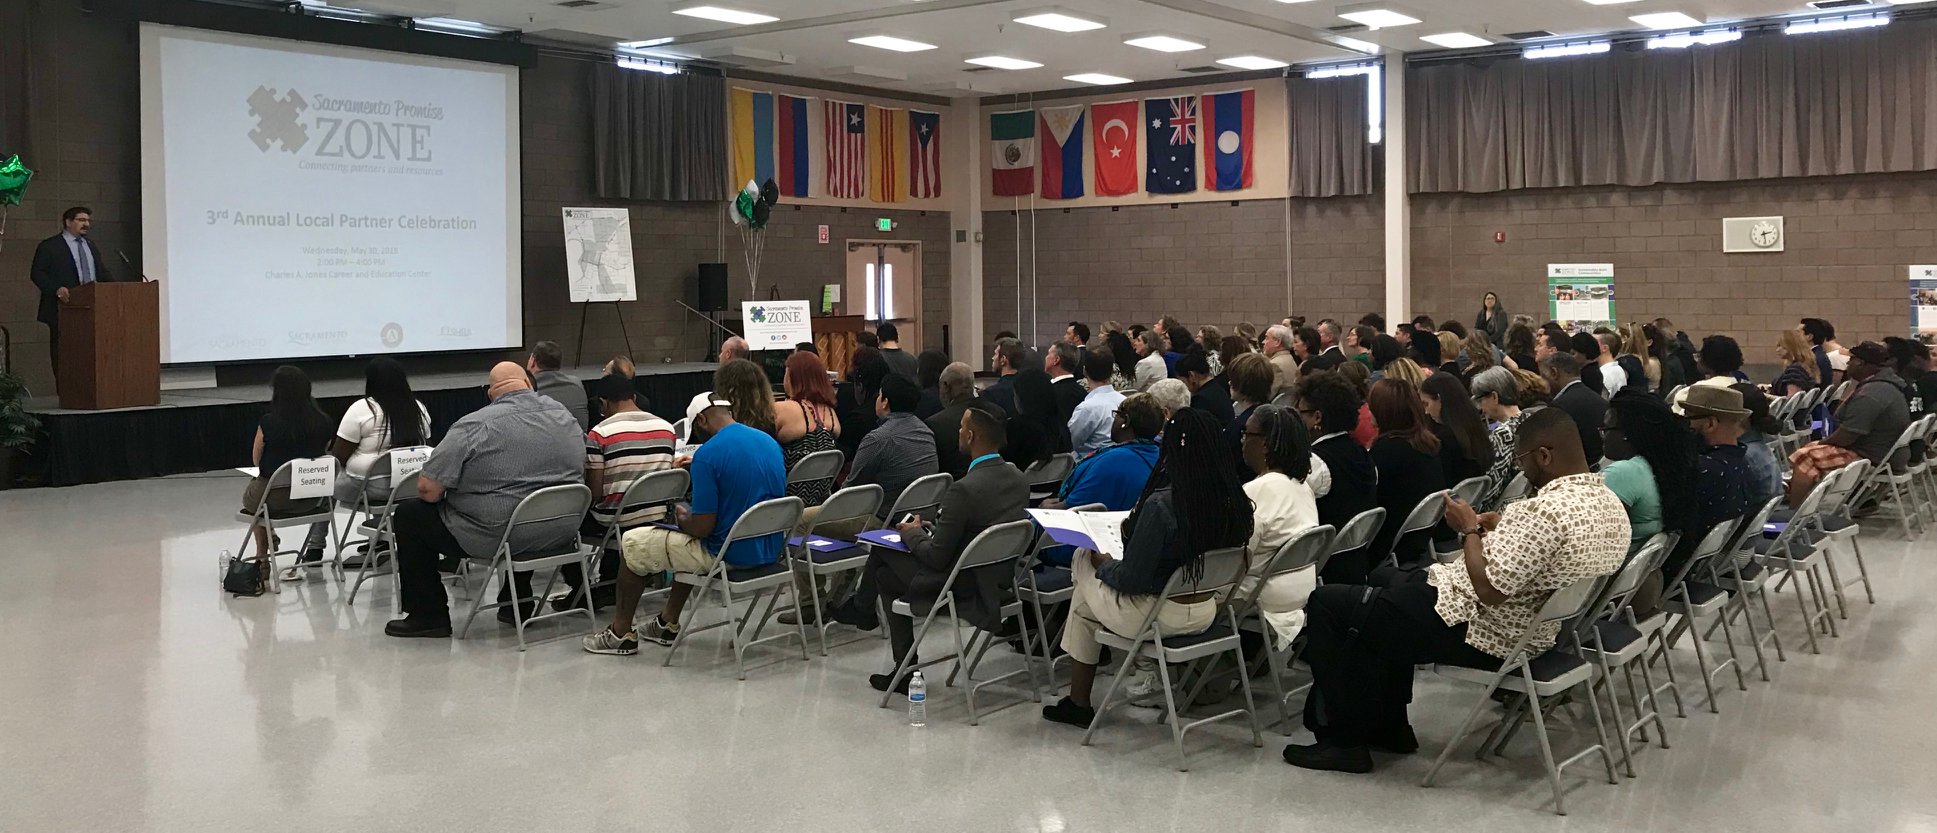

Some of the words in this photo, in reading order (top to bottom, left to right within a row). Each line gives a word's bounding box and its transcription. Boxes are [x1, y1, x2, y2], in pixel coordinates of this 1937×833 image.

[311, 93, 391, 116] Sacramento
[394, 99, 444, 121] Promise
[314, 117, 432, 162] ZONE
[298, 160, 349, 174] Connecting
[350, 162, 386, 174] partners
[388, 165, 404, 174] and
[405, 166, 443, 176] resources
[206, 209, 229, 225] 3rd
[233, 211, 290, 227] Annual
[296, 213, 335, 228] Local
[339, 213, 394, 229] Partner
[397, 214, 477, 230] Celebration
[302, 246, 349, 256] Wednesday,
[351, 246, 366, 257] May
[336, 258, 348, 266] PM
[374, 258, 386, 266] PM
[265, 271, 295, 280] Charles
[305, 270, 327, 279] Jones
[329, 270, 353, 279] Career
[356, 270, 369, 278] and
[371, 269, 406, 278] Education
[768, 311, 801, 323] ZONE
[288, 330, 348, 340] SACRAMENTO
[398, 453, 427, 464] Reserved
[298, 465, 329, 474] Reserved
[301, 477, 326, 486] Seating
